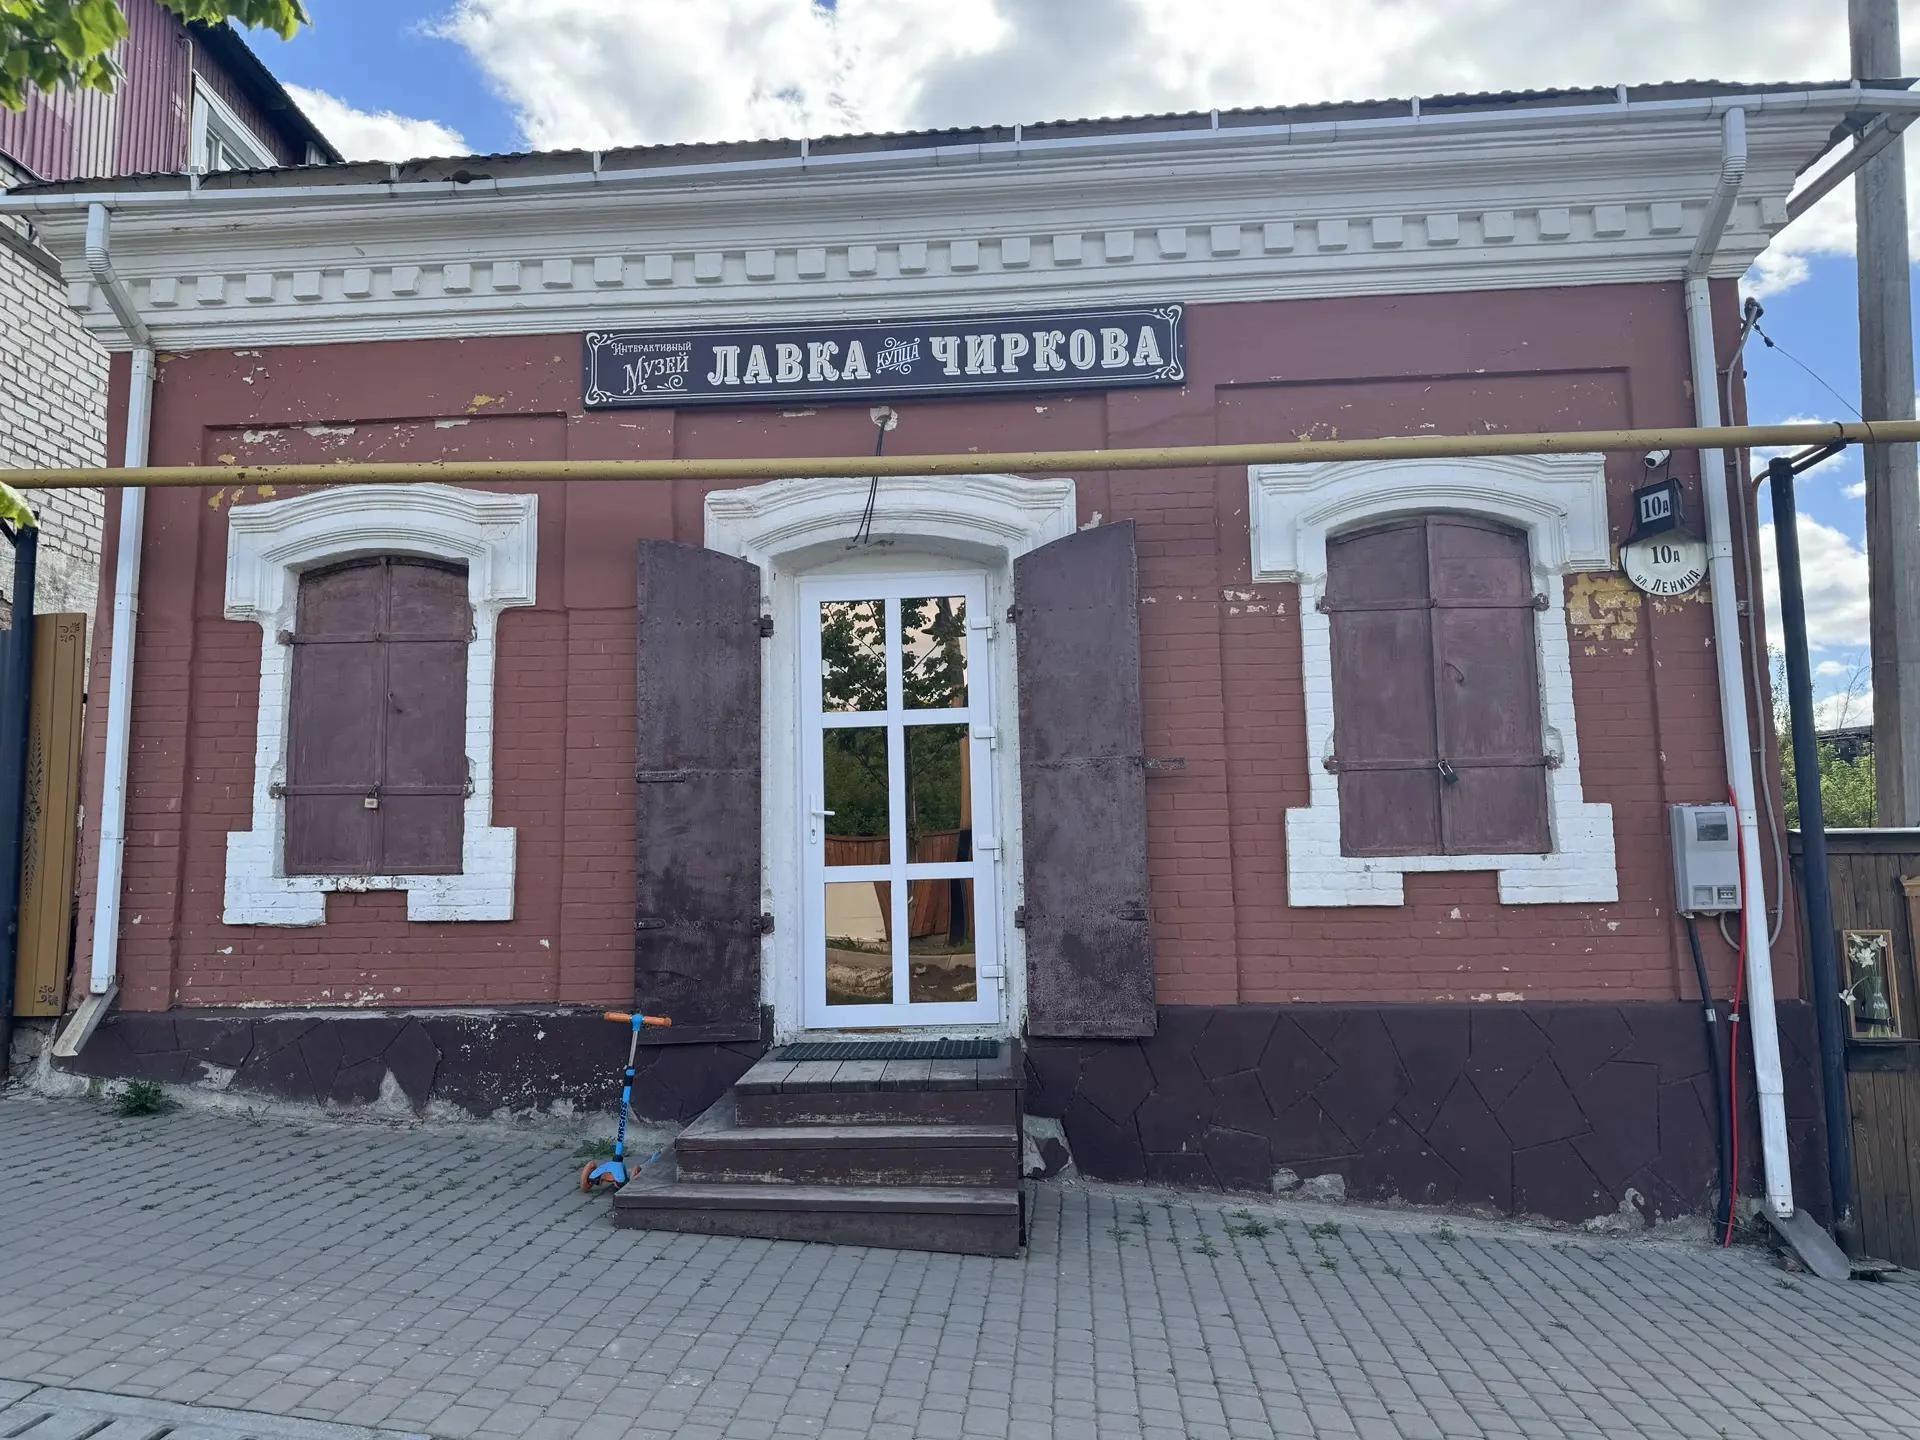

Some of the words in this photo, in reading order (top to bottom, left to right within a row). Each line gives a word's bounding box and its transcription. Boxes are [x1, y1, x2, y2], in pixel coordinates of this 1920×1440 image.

[707, 340, 871, 386] ЛАВКА
[876, 342, 920, 369] КУПЦА
[929, 325, 1164, 375] ЧИРКОВА
[1651, 570, 1701, 593] ЛЕНИНА
